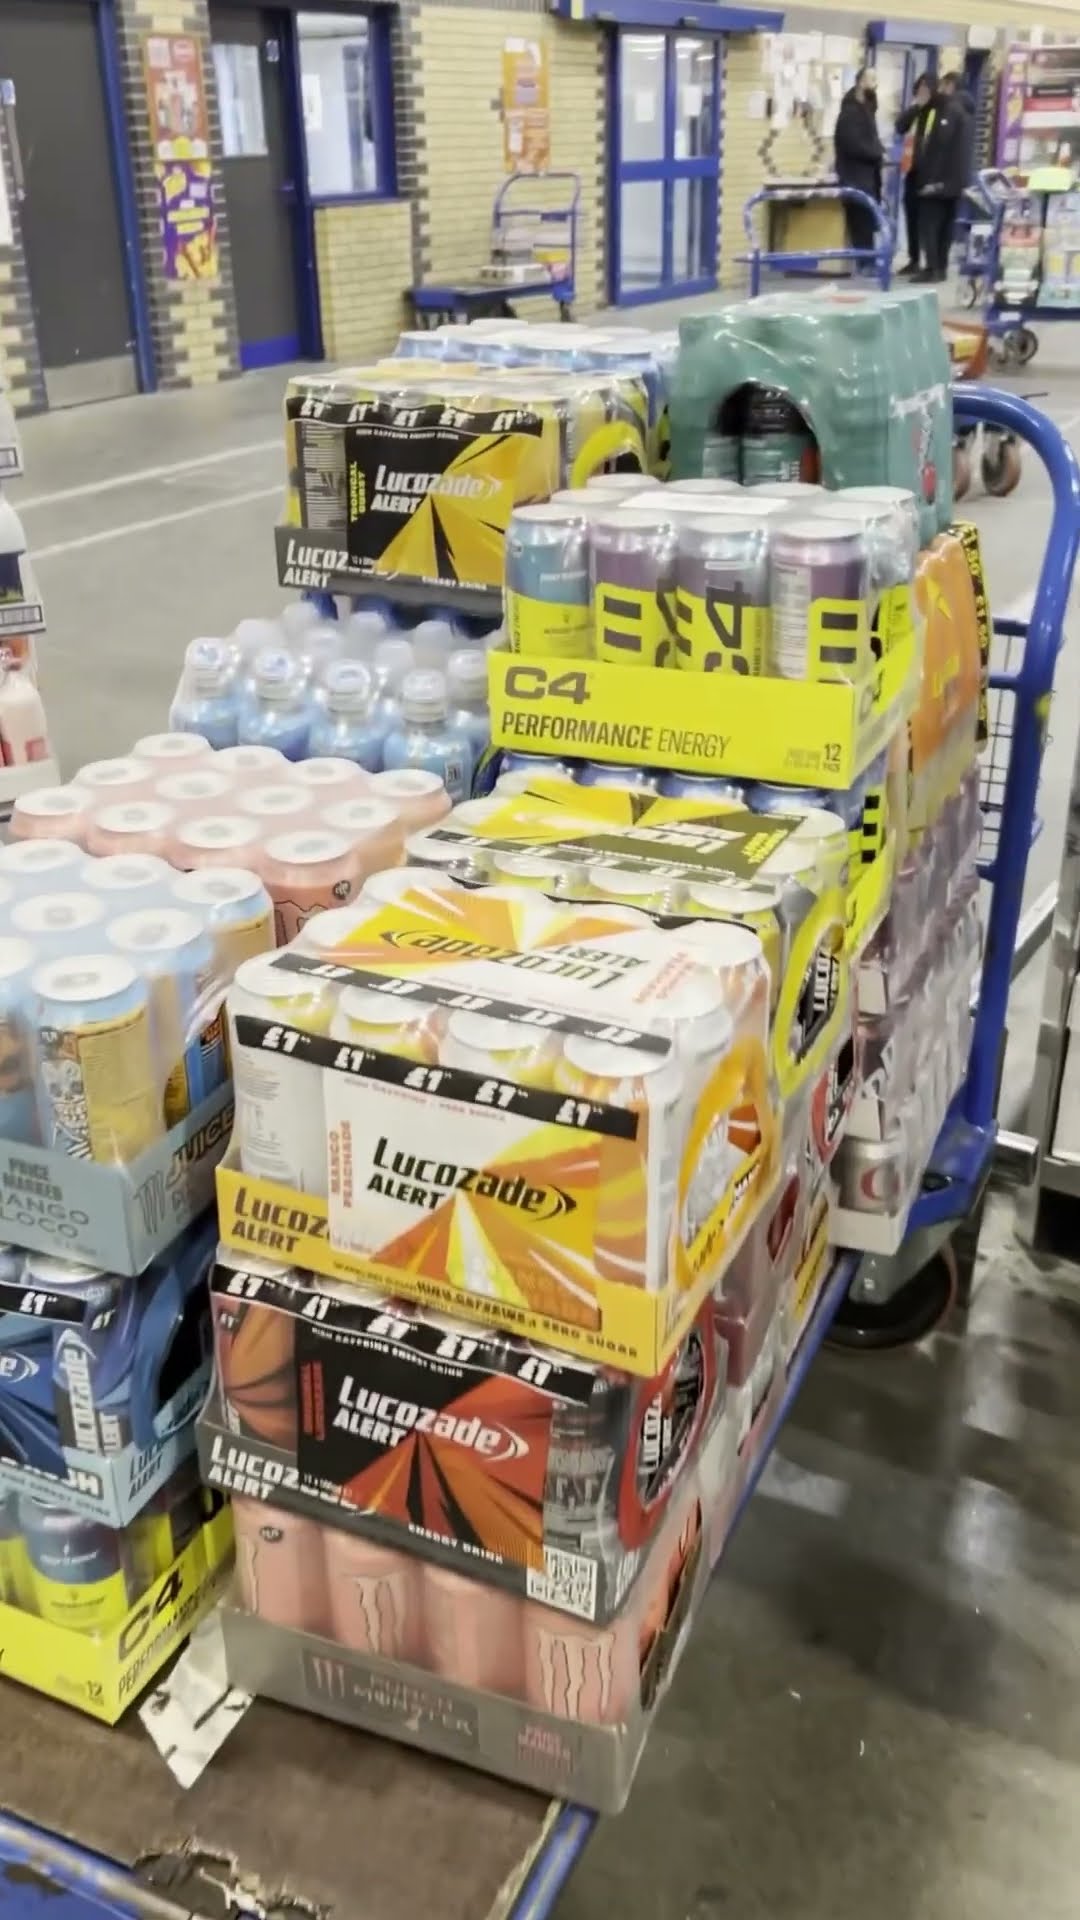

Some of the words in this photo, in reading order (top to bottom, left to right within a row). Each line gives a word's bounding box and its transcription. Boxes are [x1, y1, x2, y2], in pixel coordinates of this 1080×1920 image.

[370, 494, 423, 514] ALERT
[286, 539, 348, 571] Lucoz
[283, 568, 331, 588] ALERT
[504, 665, 591, 705] C4
[501, 711, 654, 751] PERFORMANCE
[657, 728, 733, 760] ENERGY
[824, 743, 842, 762] 12
[262, 1025, 299, 1052] £1
[334, 1046, 364, 1072] £1
[404, 1066, 443, 1092] £1
[475, 1080, 516, 1108] £1
[555, 1098, 591, 1127] £1
[367, 1172, 446, 1210] ALERT
[373, 1136, 548, 1213] Lucozade
[0, 1190, 90, 1226] ANGO
[234, 1187, 329, 1241] Lucoz
[231, 1219, 300, 1252] ALERT
[332, 1407, 407, 1448] ALERT
[337, 1375, 502, 1455] Lucozade
[207, 1464, 275, 1500] ALERT
[210, 1435, 299, 1490] Lucoz
[118, 1570, 183, 1661] C4
